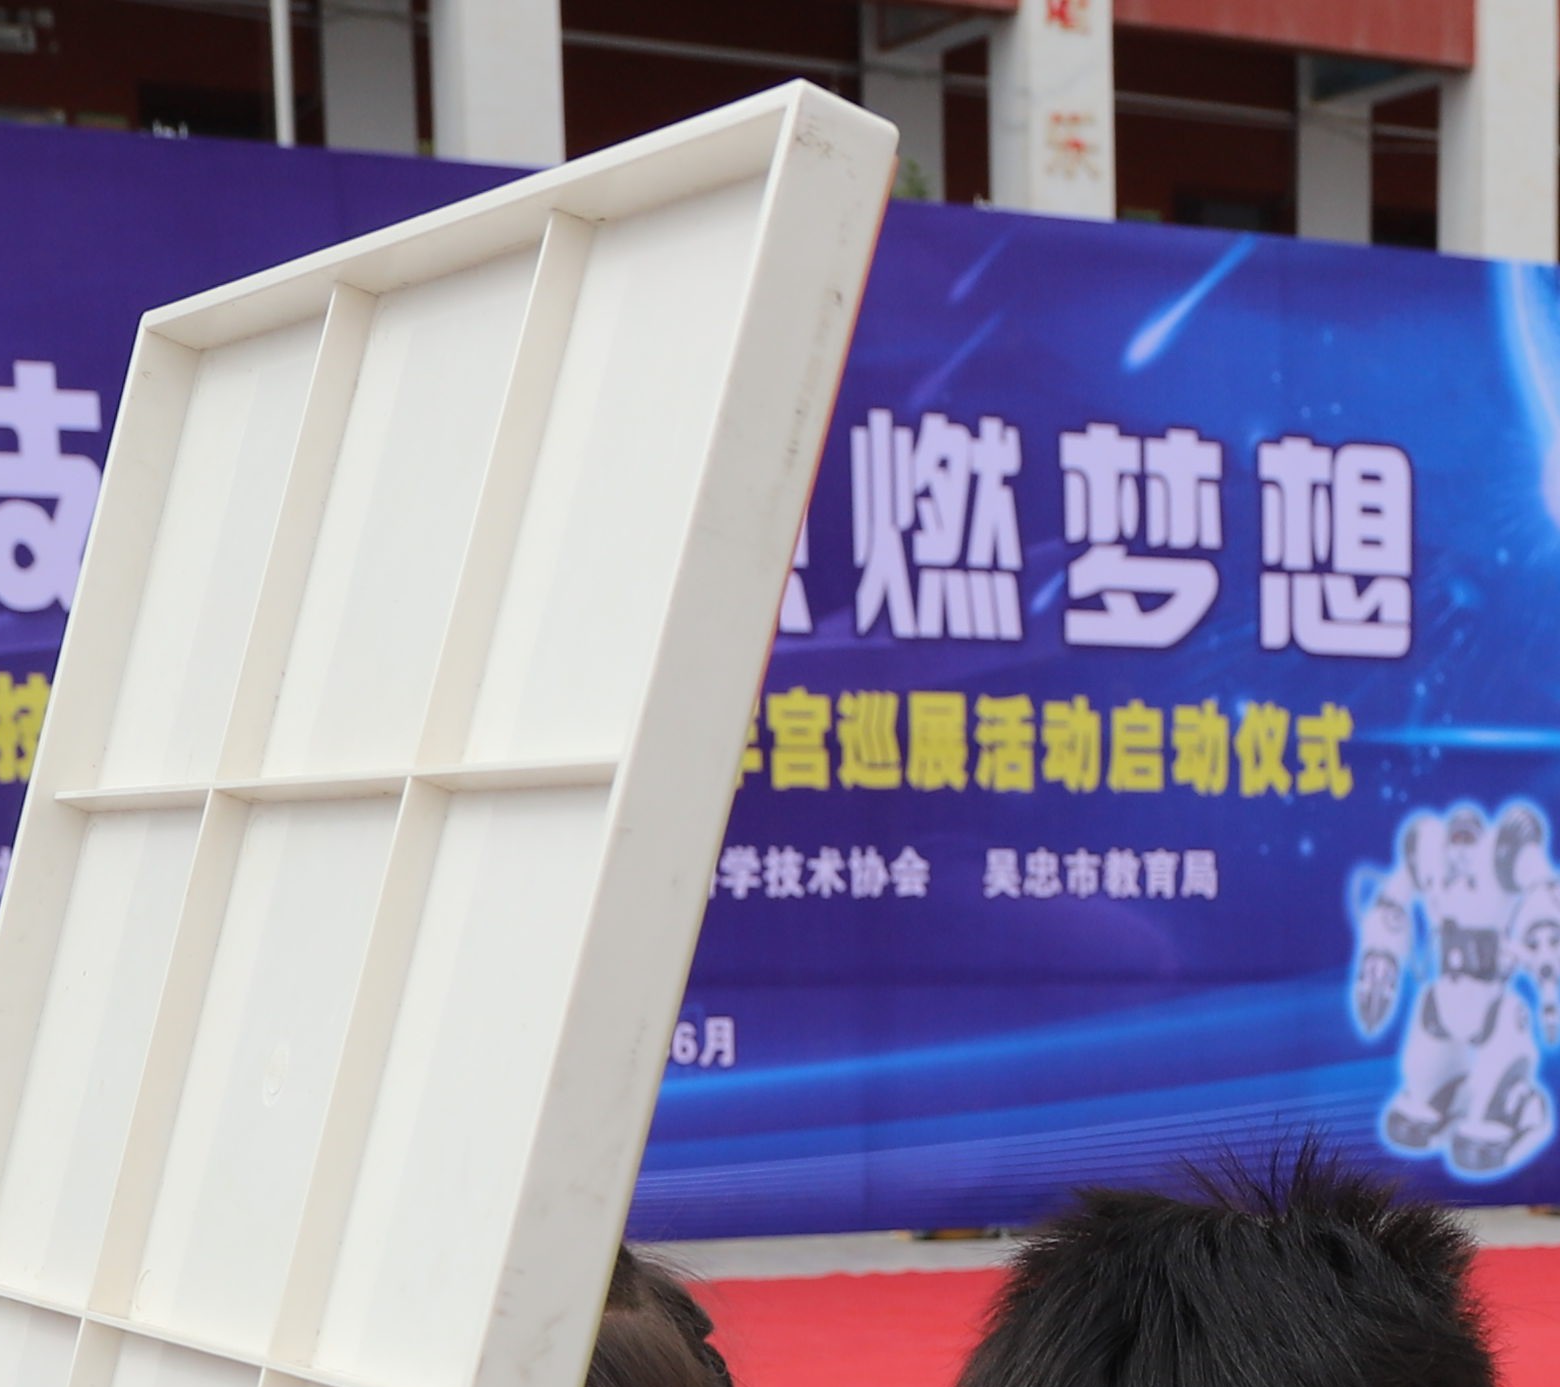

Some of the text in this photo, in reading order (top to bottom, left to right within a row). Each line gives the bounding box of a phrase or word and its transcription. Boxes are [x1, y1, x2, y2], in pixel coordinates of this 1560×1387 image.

[778, 408, 1412, 659] 燃梦想
[709, 846, 931, 899] 学技术协会
[982, 847, 1219, 899] 吴忠市教育局
[667, 1016, 737, 1068] 6月
